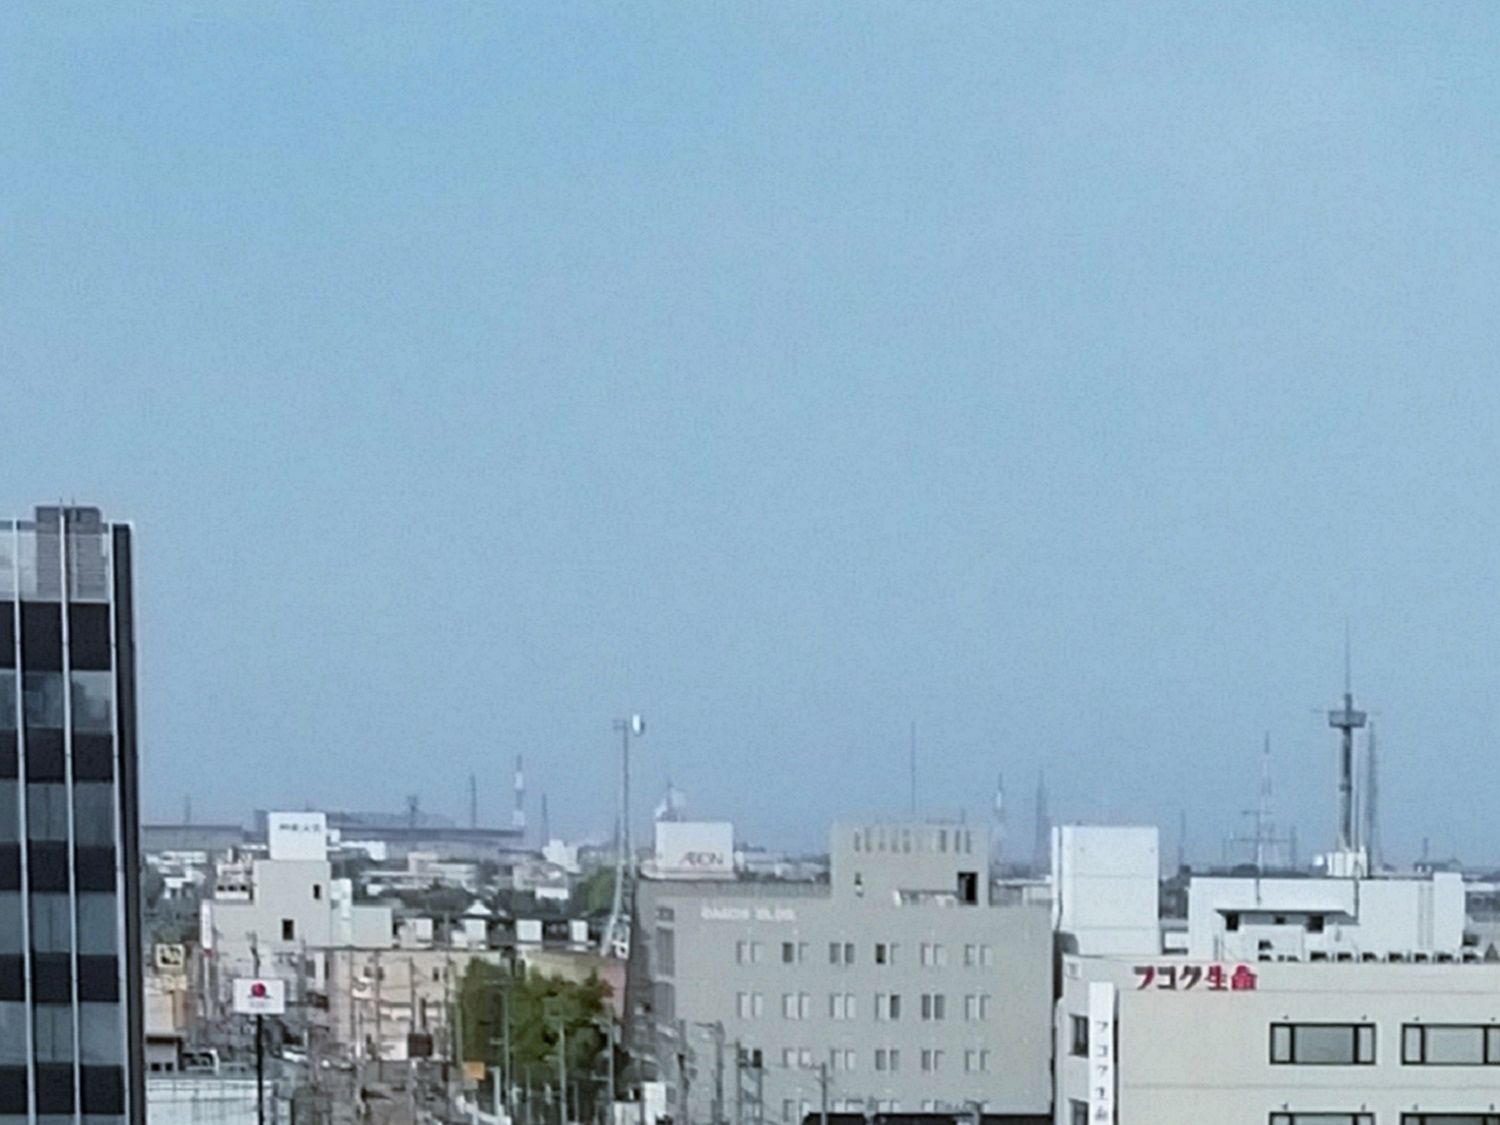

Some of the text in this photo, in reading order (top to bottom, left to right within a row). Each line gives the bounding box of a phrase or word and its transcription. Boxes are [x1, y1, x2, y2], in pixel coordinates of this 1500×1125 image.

[1133, 964, 1257, 991] フコク生命
